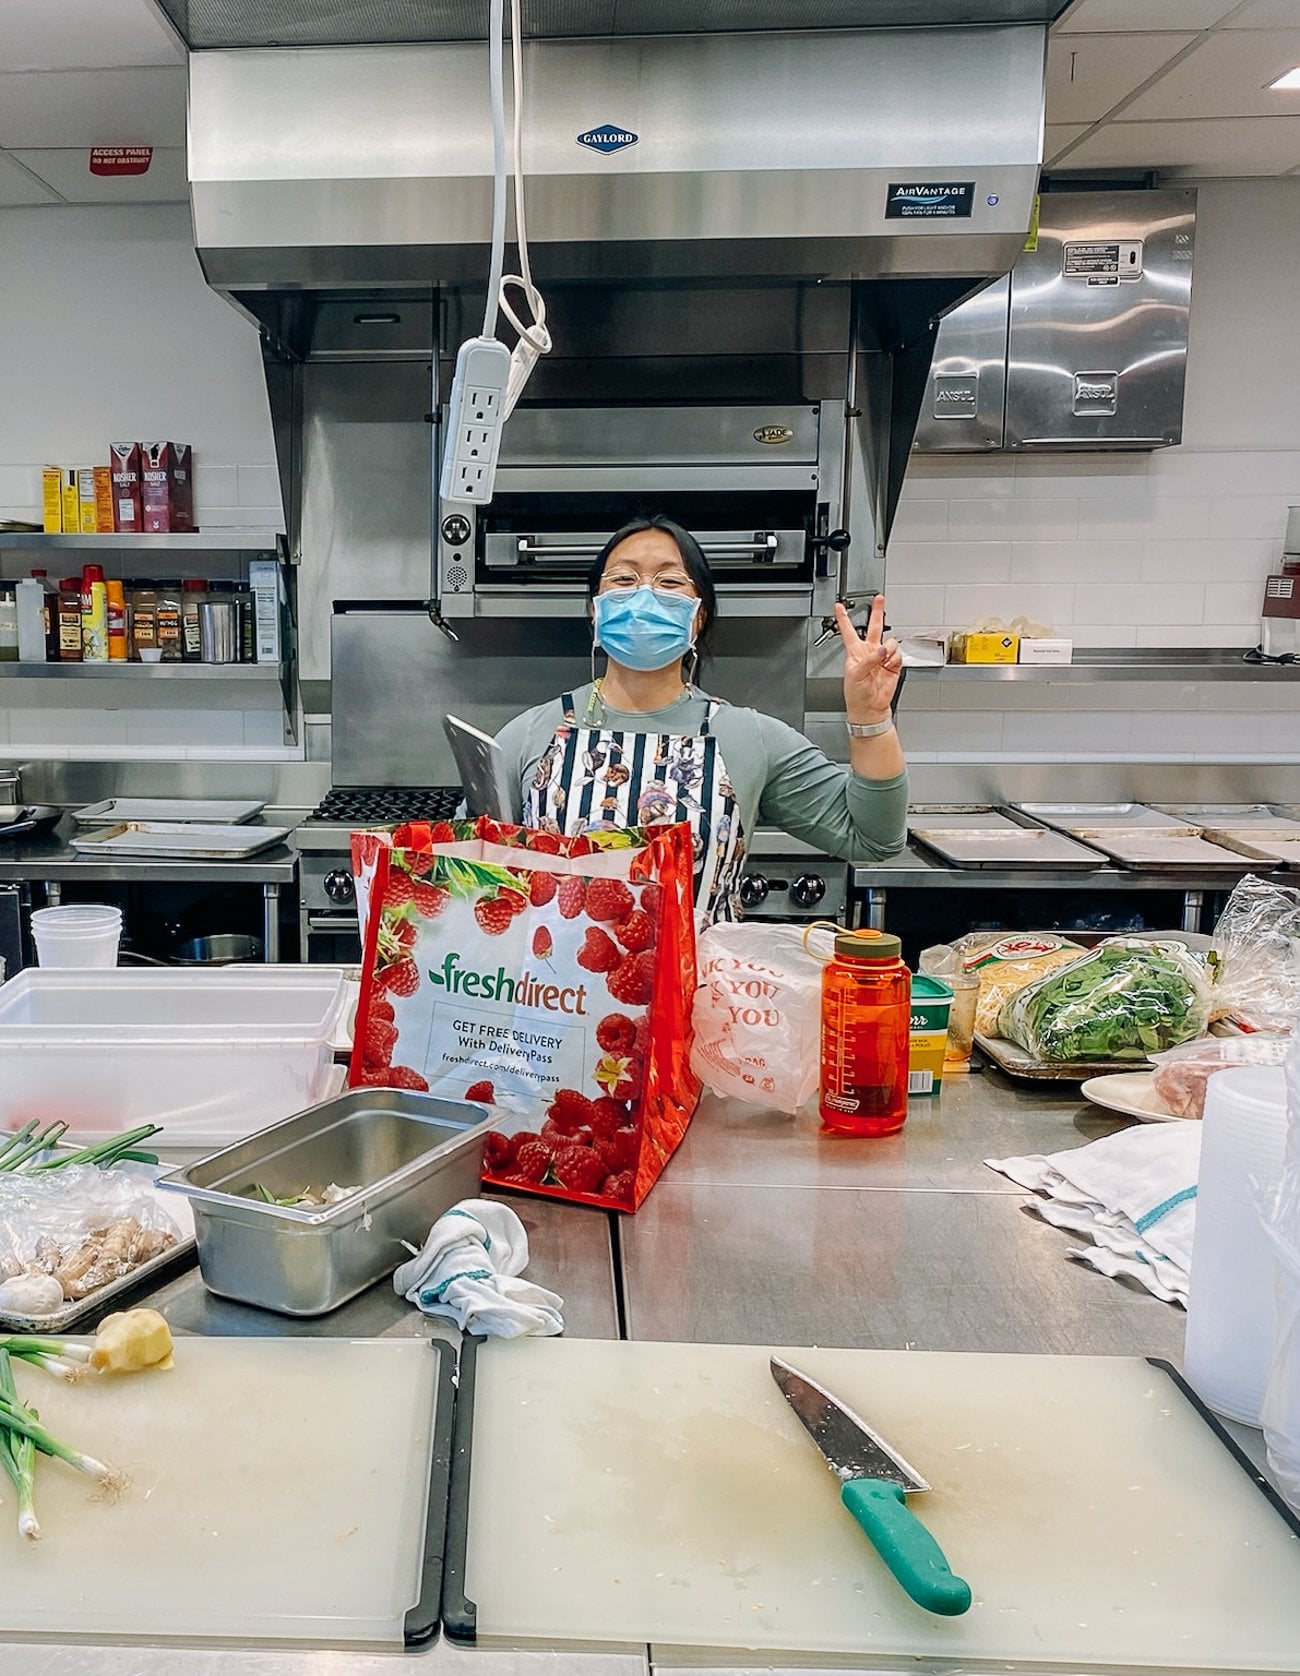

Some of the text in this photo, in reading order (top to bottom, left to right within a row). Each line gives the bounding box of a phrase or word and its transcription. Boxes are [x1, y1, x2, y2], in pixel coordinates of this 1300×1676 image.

[583, 133, 633, 143] GAYLORD
[113, 471, 137, 483] KOSHER
[144, 471, 167, 482] KOSHER
[440, 952, 587, 1015] freshdirect
[729, 980, 781, 1000] YOU
[728, 1006, 780, 1027] YOU
[452, 1019, 563, 1050] GET FREE DELIVERY
[458, 1036, 553, 1064] With DeliveryPass
[442, 1053, 560, 1083] freshdirect.com/deliverypass
